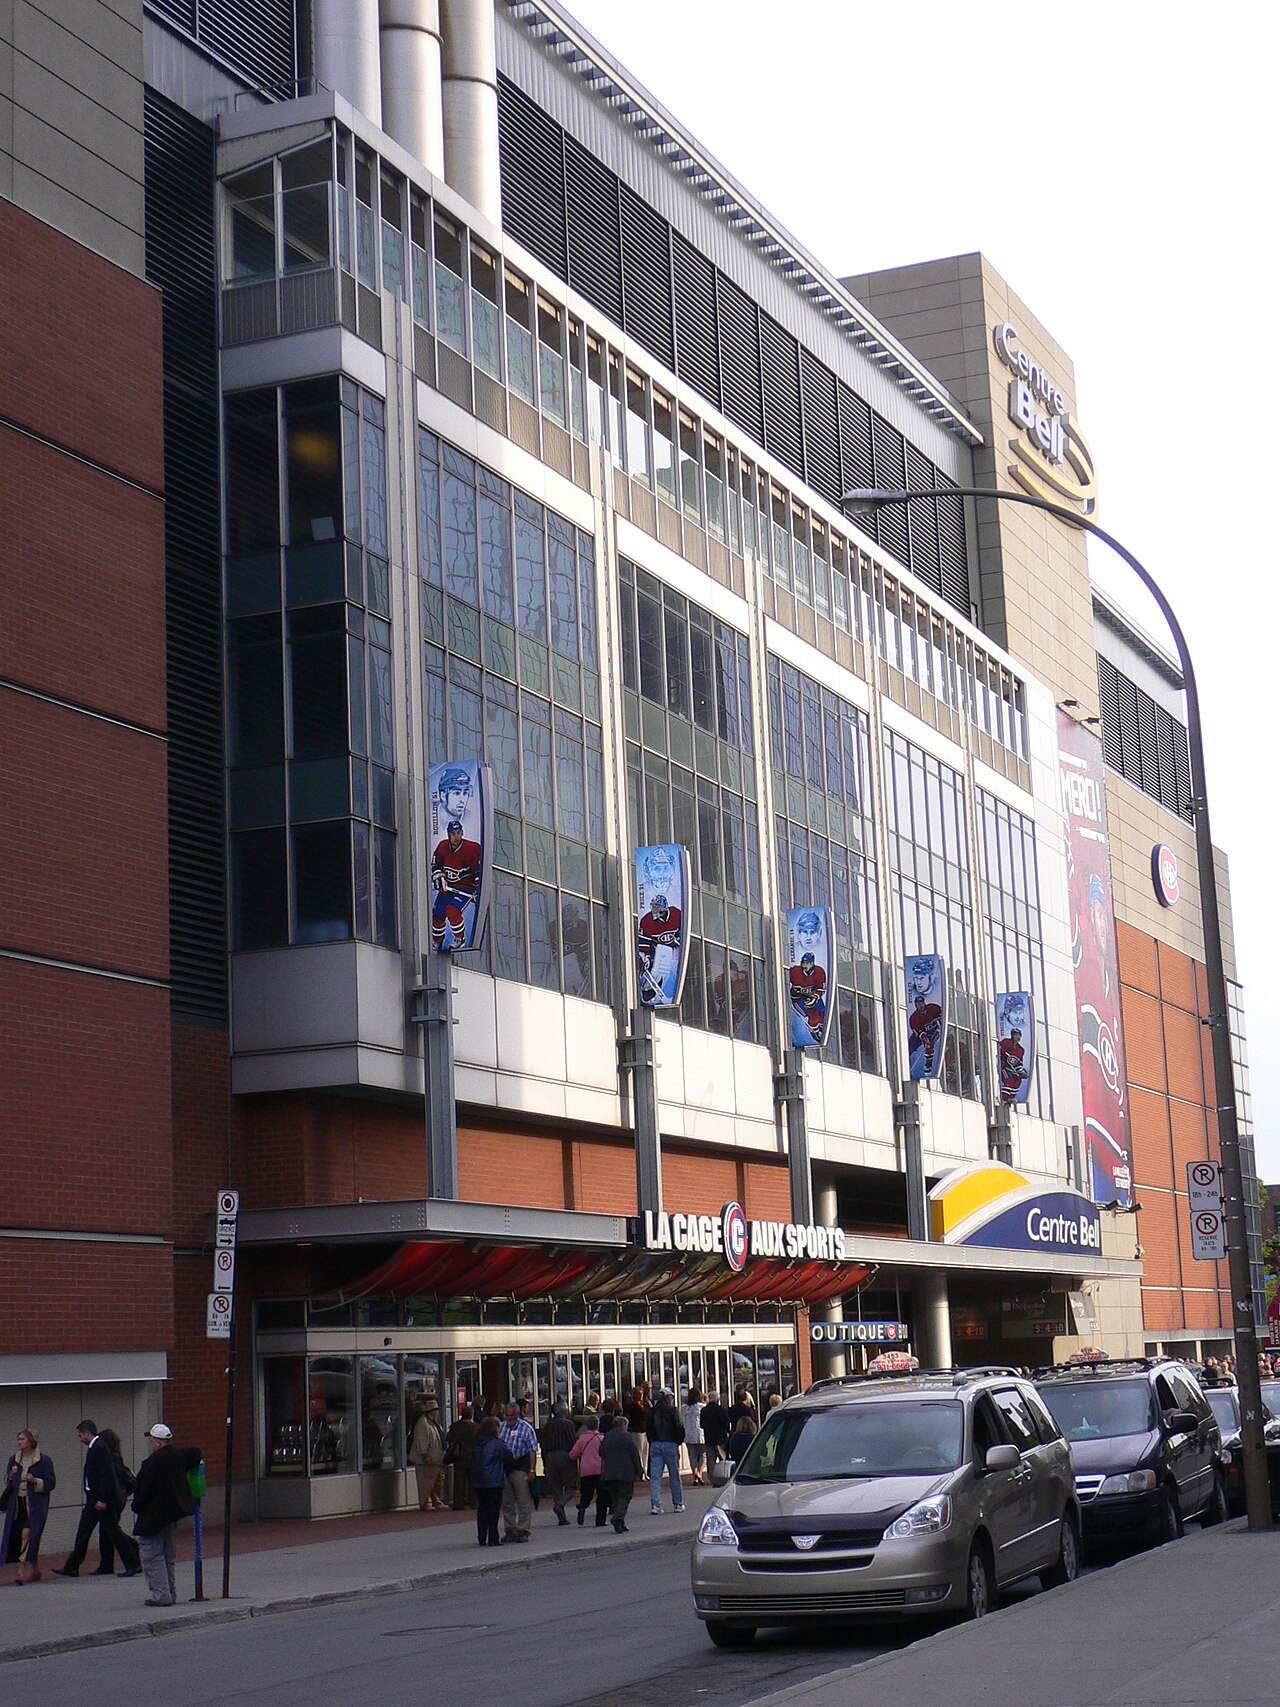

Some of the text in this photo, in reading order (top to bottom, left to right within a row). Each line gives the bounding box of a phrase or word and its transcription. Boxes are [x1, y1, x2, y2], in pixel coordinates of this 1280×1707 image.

[996, 321, 1065, 416] Centre
[1010, 378, 1065, 466] Bell
[432, 791, 438, 799] 51
[644, 1209, 672, 1250] LA
[672, 1213, 724, 1253] CAGE
[751, 1220, 786, 1257] AUX
[785, 1223, 846, 1261] SPORTS
[1026, 1207, 1100, 1248] Centre Bell
